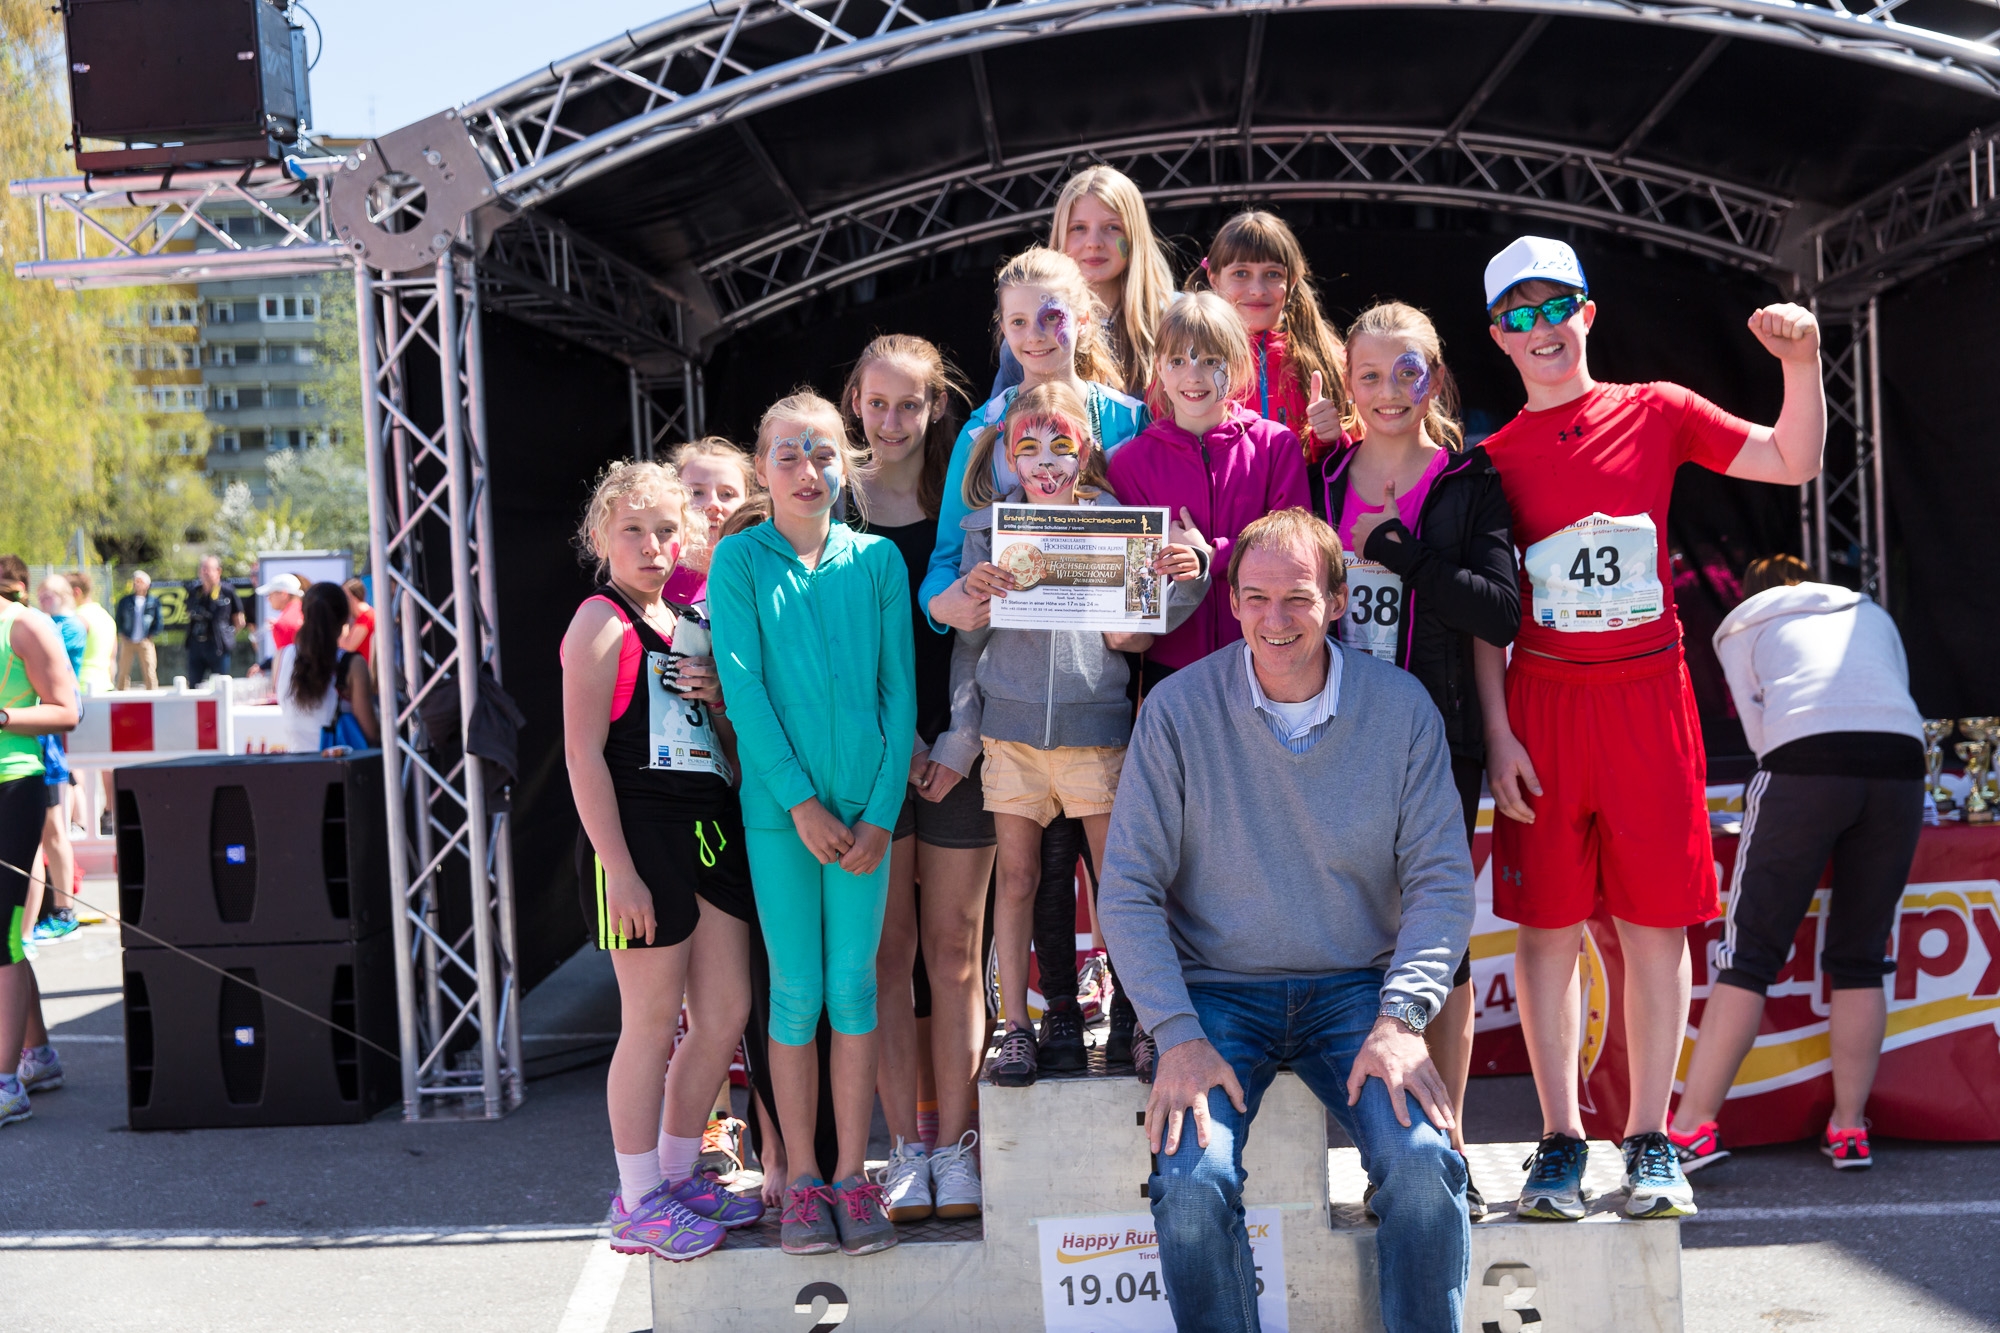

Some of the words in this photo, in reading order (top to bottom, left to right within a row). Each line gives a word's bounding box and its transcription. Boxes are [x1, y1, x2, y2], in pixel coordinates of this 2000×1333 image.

[1049, 561, 1122, 572] HOCHSEILGARTEN
[1056, 569, 1117, 580] WILDSCHÖNAU
[1568, 545, 1621, 588] 43
[1351, 584, 1399, 627] 38
[1061, 1232, 1121, 1251] Happy
[794, 1281, 850, 1333] 2
[1481, 1260, 1543, 1333] 3
